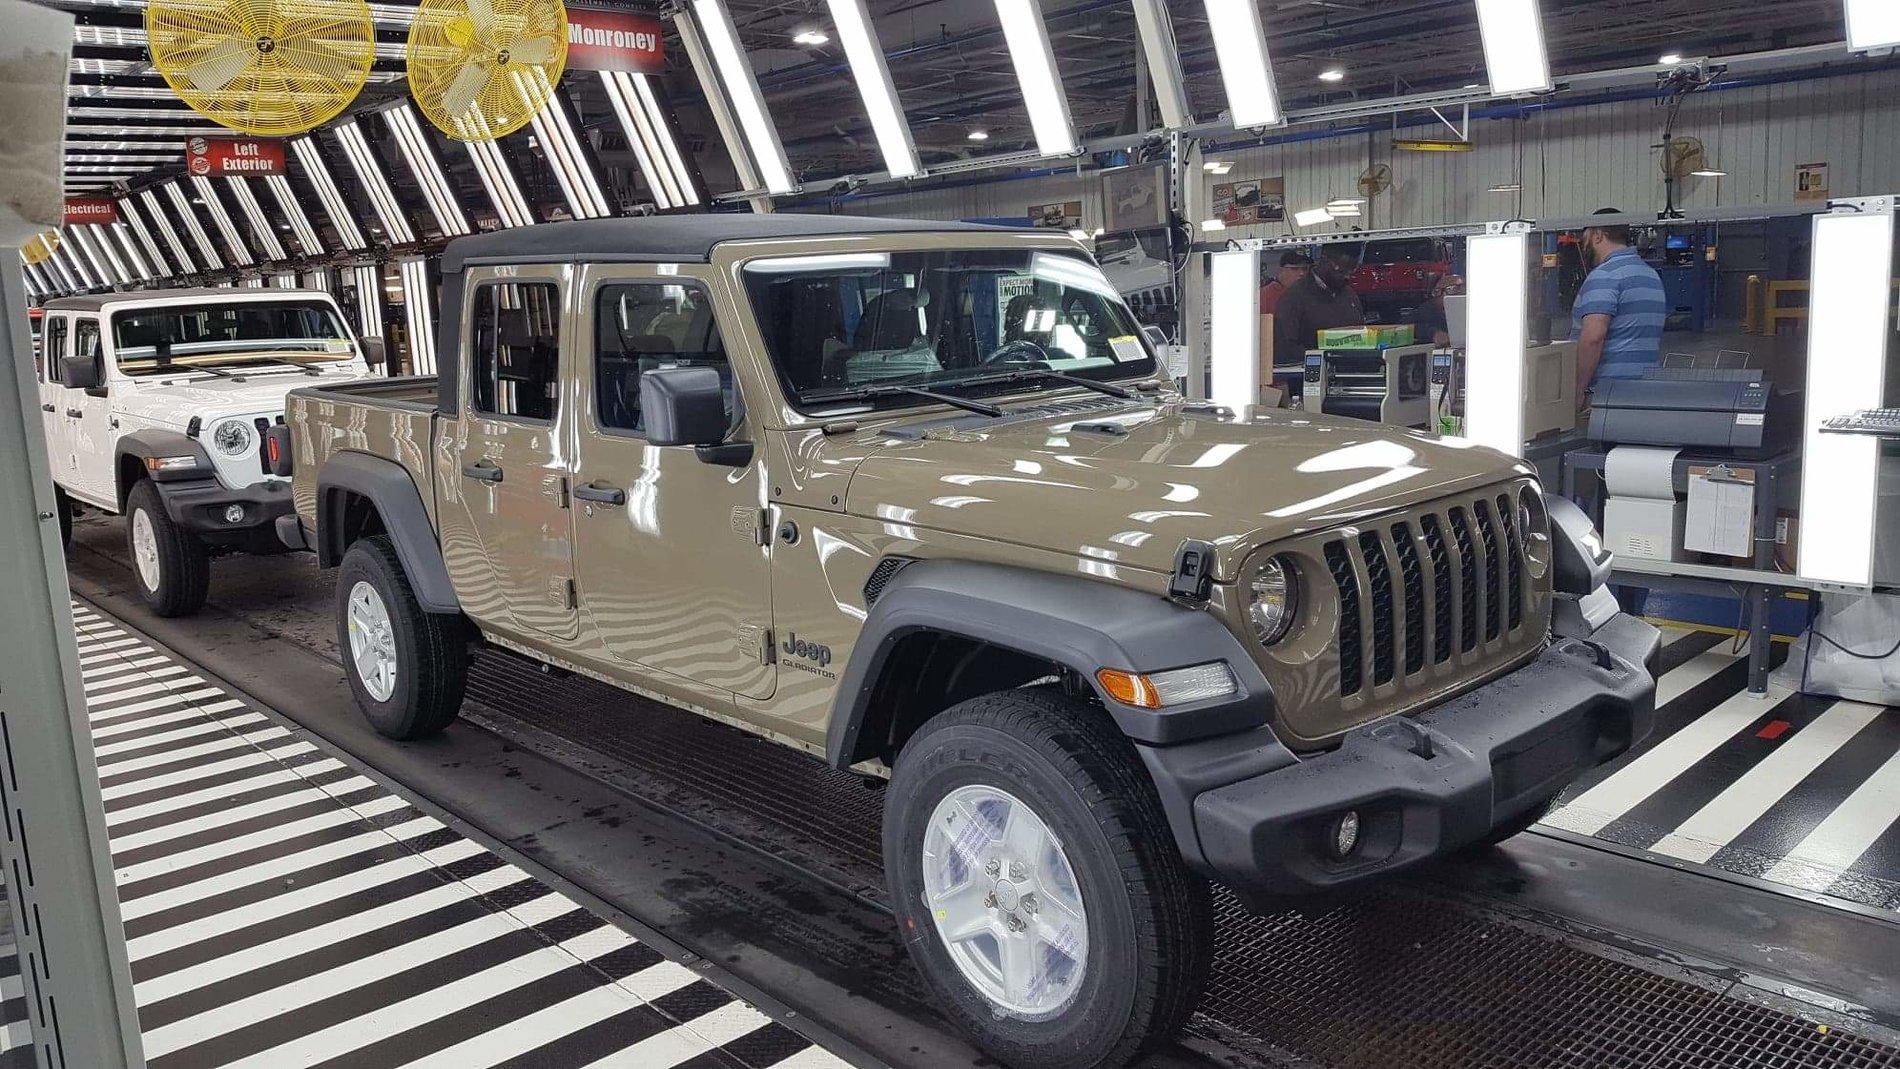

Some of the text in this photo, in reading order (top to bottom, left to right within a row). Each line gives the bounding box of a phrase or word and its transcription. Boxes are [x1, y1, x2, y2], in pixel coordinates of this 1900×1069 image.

[567, 23, 656, 52] Monroney
[234, 143, 259, 156] Left
[222, 157, 273, 171] Exterior
[63, 204, 111, 214] Electrical
[782, 631, 832, 668] Jeep
[782, 658, 837, 680] GLADIATOR
